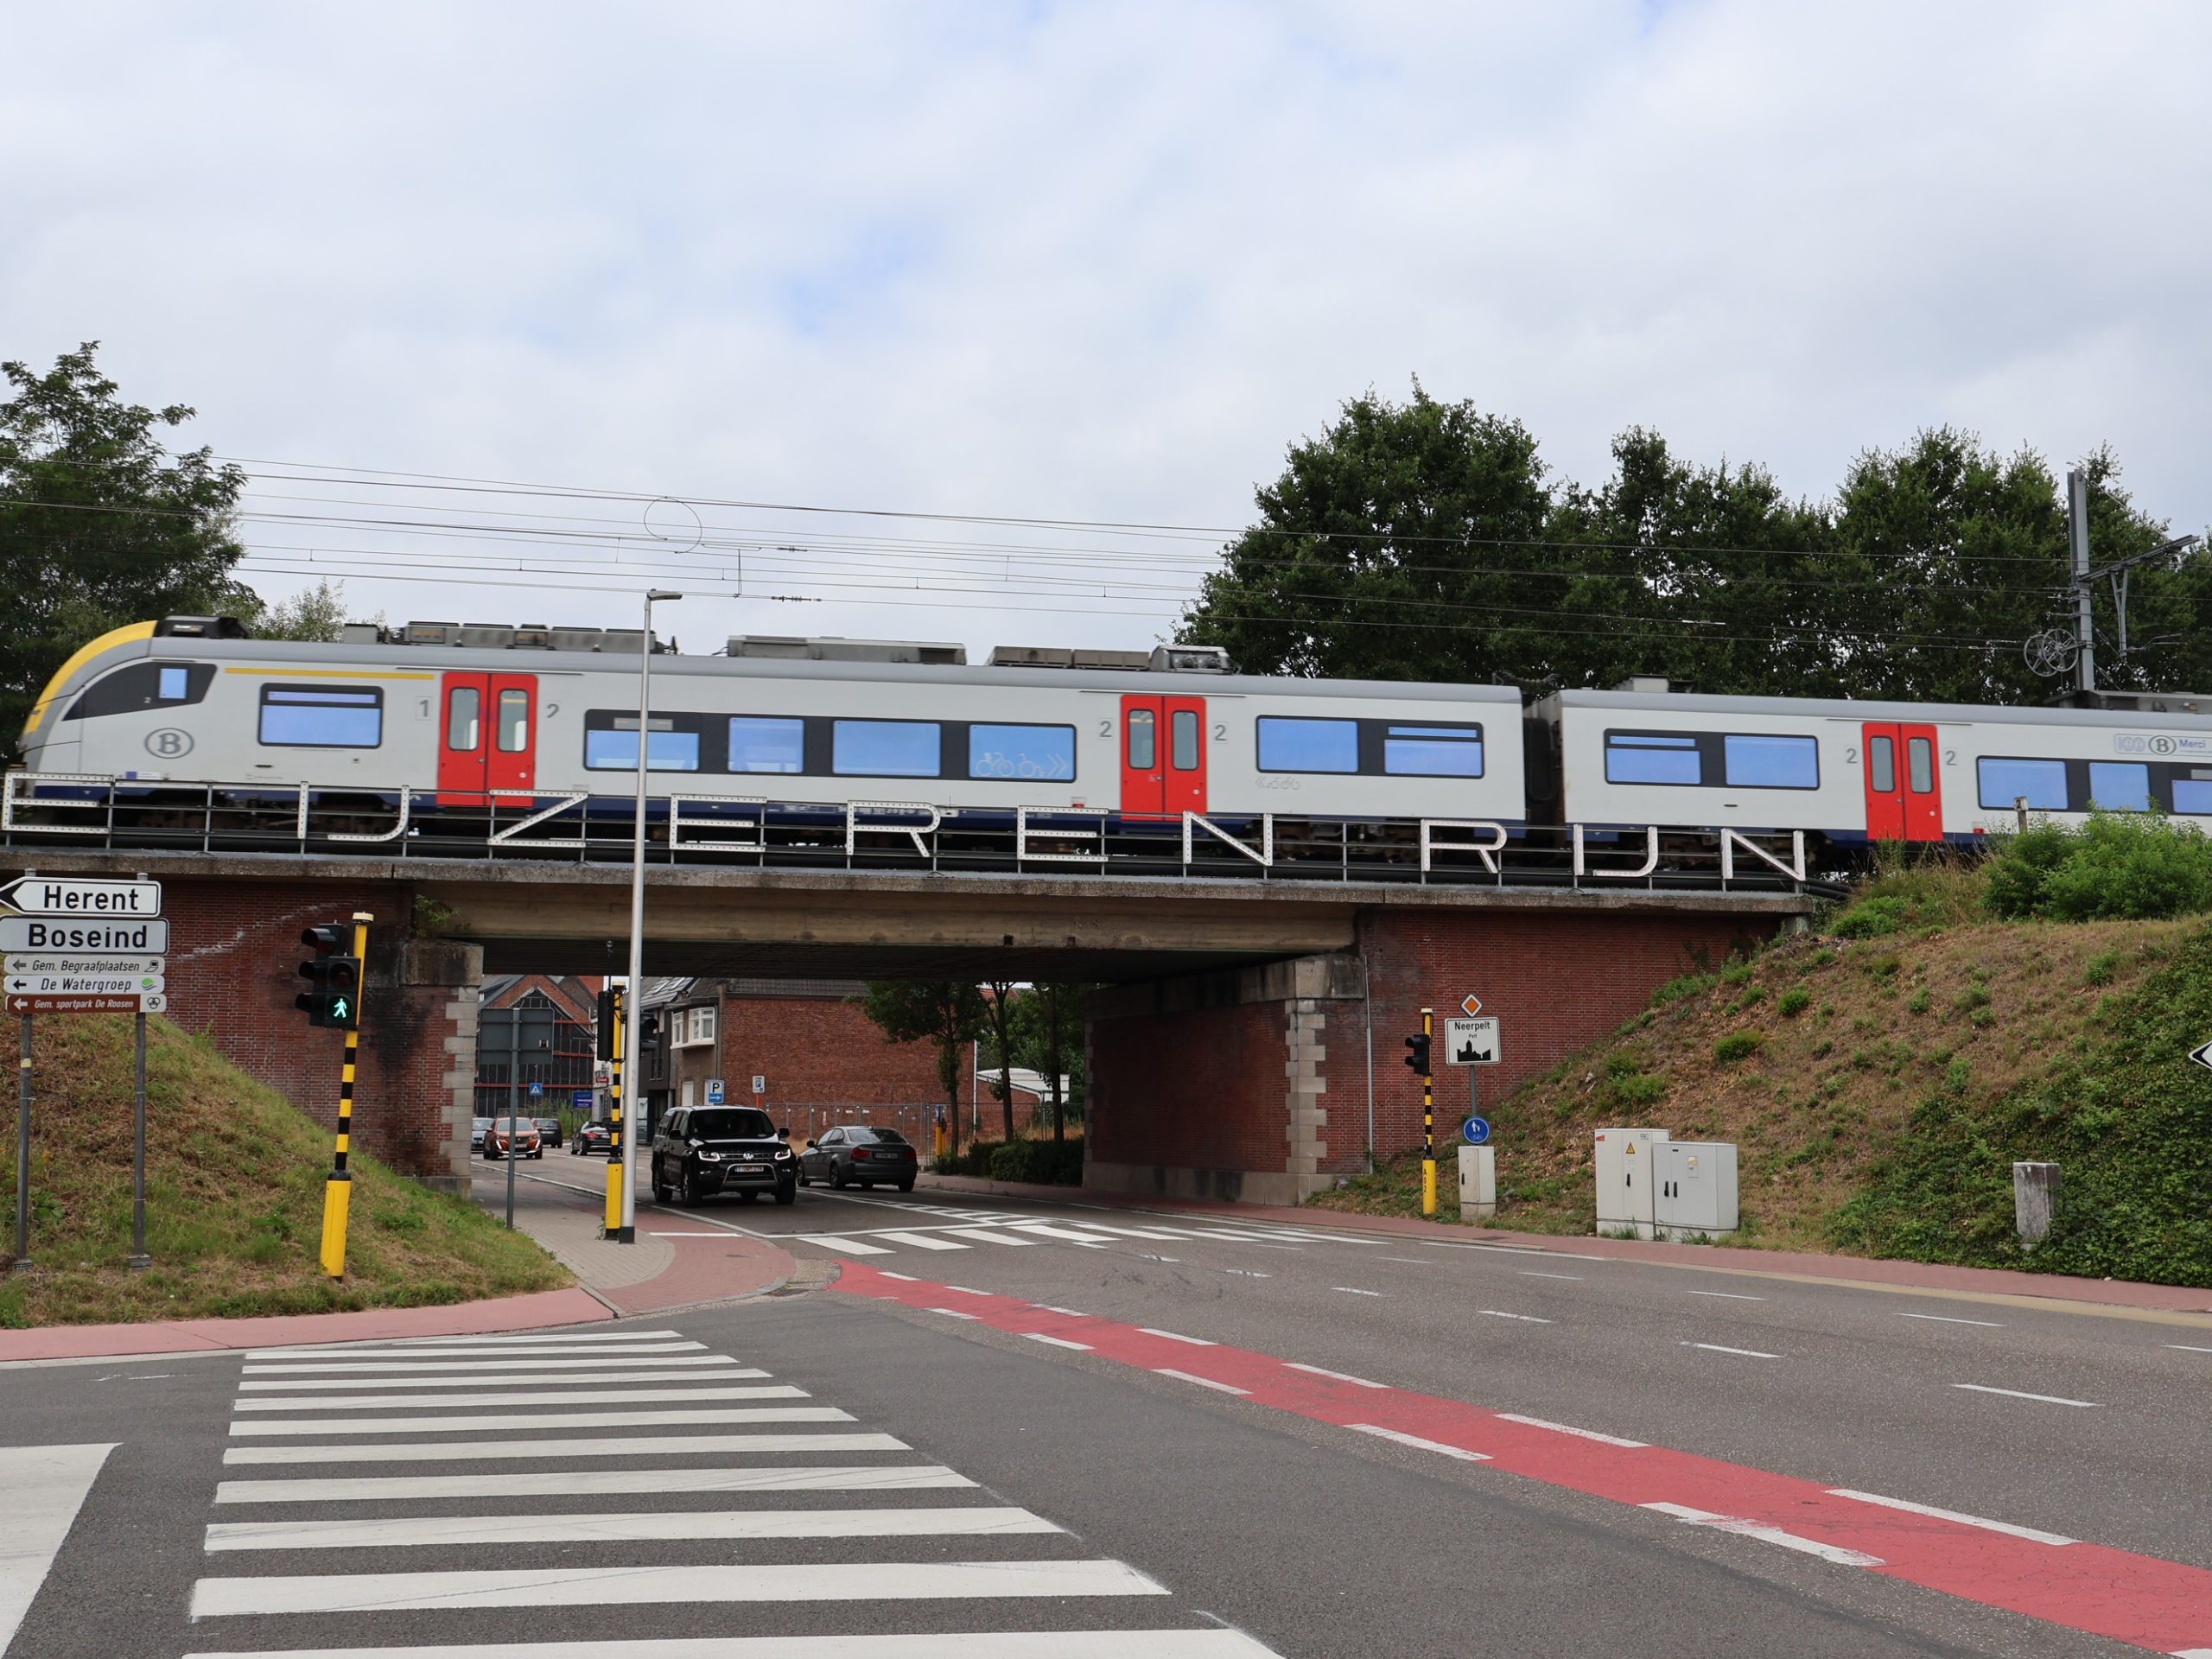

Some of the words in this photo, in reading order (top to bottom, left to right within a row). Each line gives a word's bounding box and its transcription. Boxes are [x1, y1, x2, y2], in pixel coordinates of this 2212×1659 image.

[419, 699, 429, 717] 1
[1099, 721, 1112, 738] 2
[1214, 724, 1227, 741] 2
[157, 732, 182, 754] B
[2178, 739, 2207, 749] Merci
[1846, 747, 1858, 764] 2
[1945, 750, 1957, 766] 2
[1421, 818, 1806, 881] RIJN
[43, 885, 139, 911] Herent
[28, 923, 148, 949] Boseind
[32, 959, 58, 972] Gem.
[60, 960, 140, 975] Begraafplaatsen
[41, 977, 57, 990] De
[62, 977, 132, 994] Watergroep
[34, 999, 54, 1009] Gem.
[56, 999, 92, 1010] sportpark
[94, 999, 105, 1008] De
[107, 999, 134, 1008] Roosen
[1454, 1021, 1491, 1032] Neerpelt
[712, 1083, 721, 1093] P
